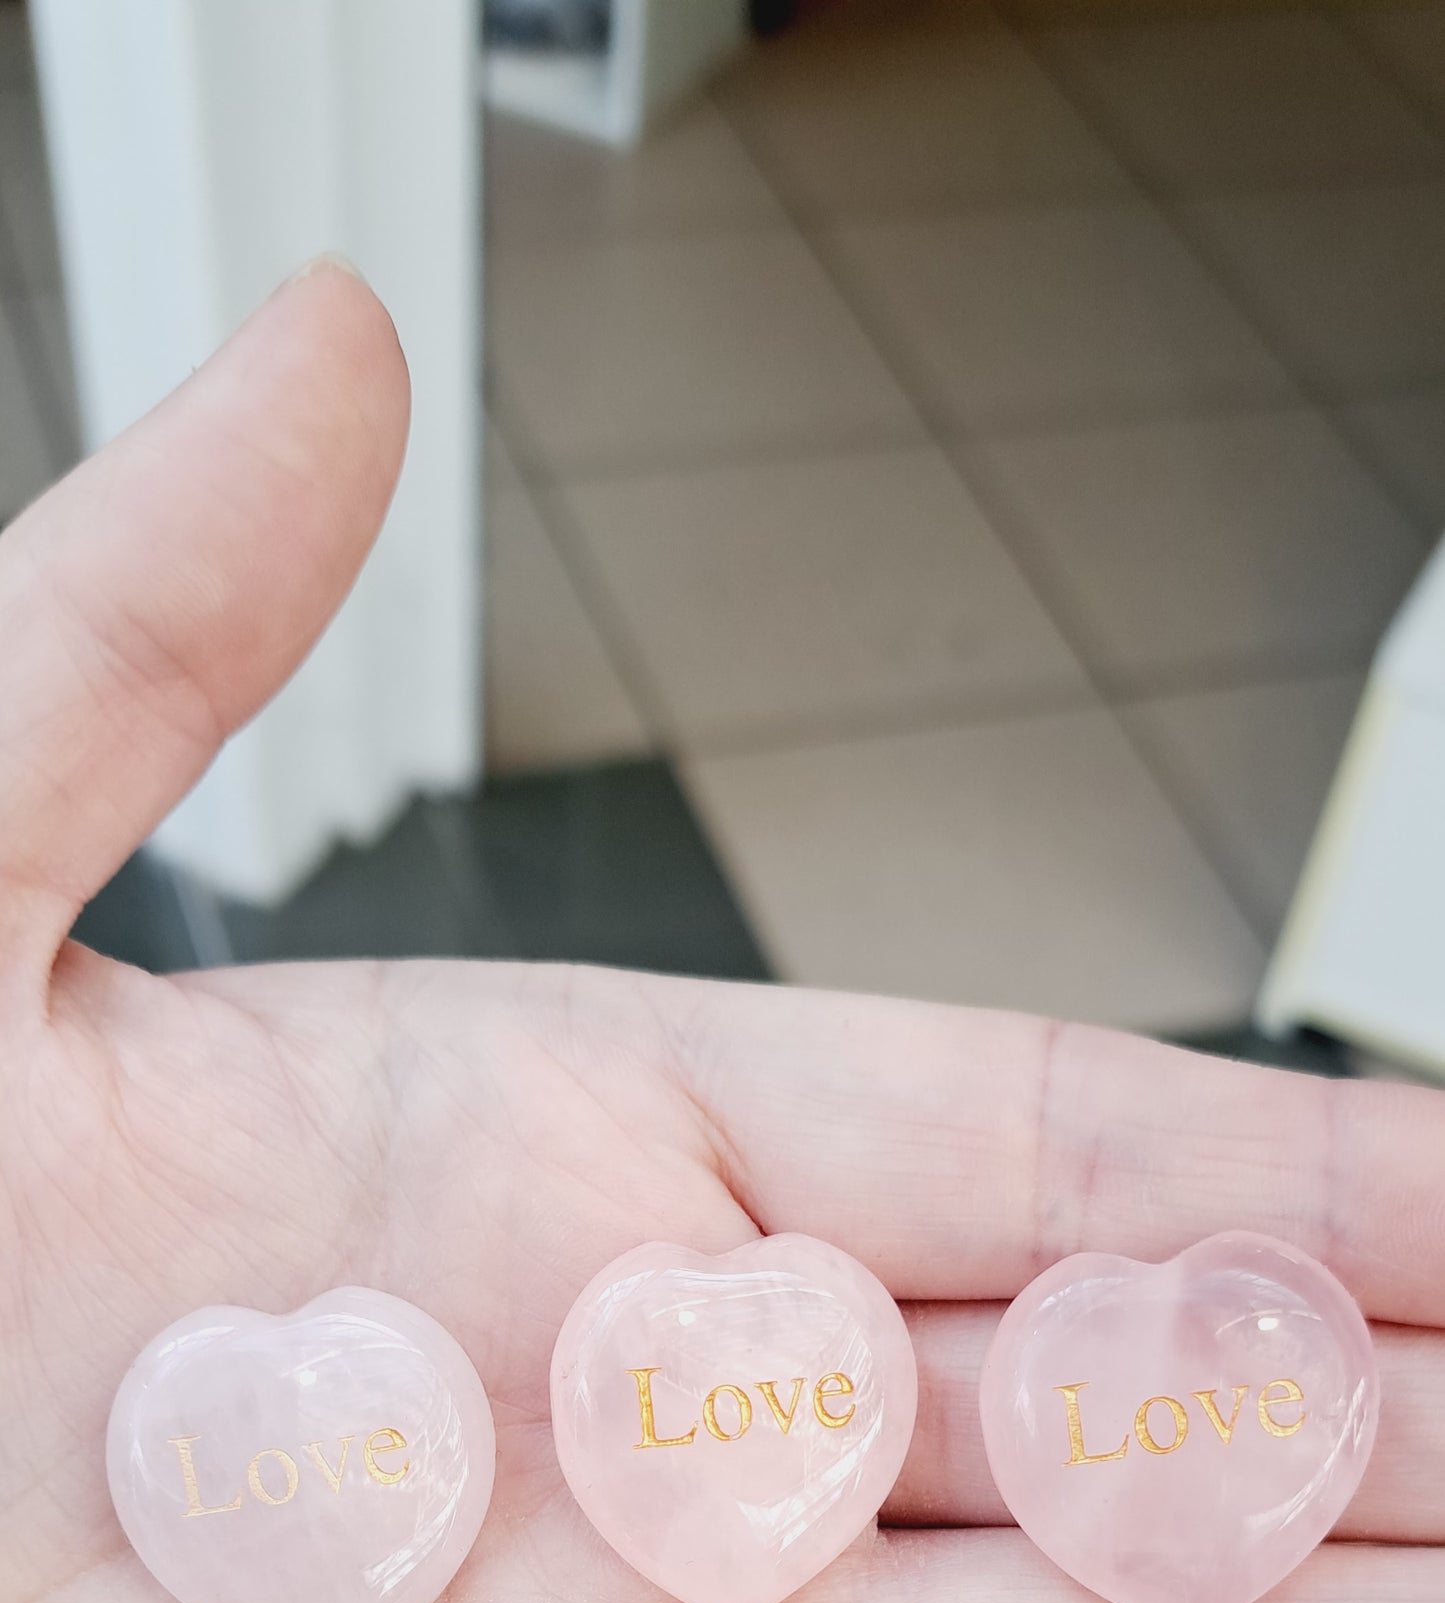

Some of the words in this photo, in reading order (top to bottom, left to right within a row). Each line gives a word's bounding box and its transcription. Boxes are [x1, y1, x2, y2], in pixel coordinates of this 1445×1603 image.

[625, 1367, 857, 1450] Love
[1053, 1378, 1307, 1467] Love
[167, 1427, 410, 1519] Love
